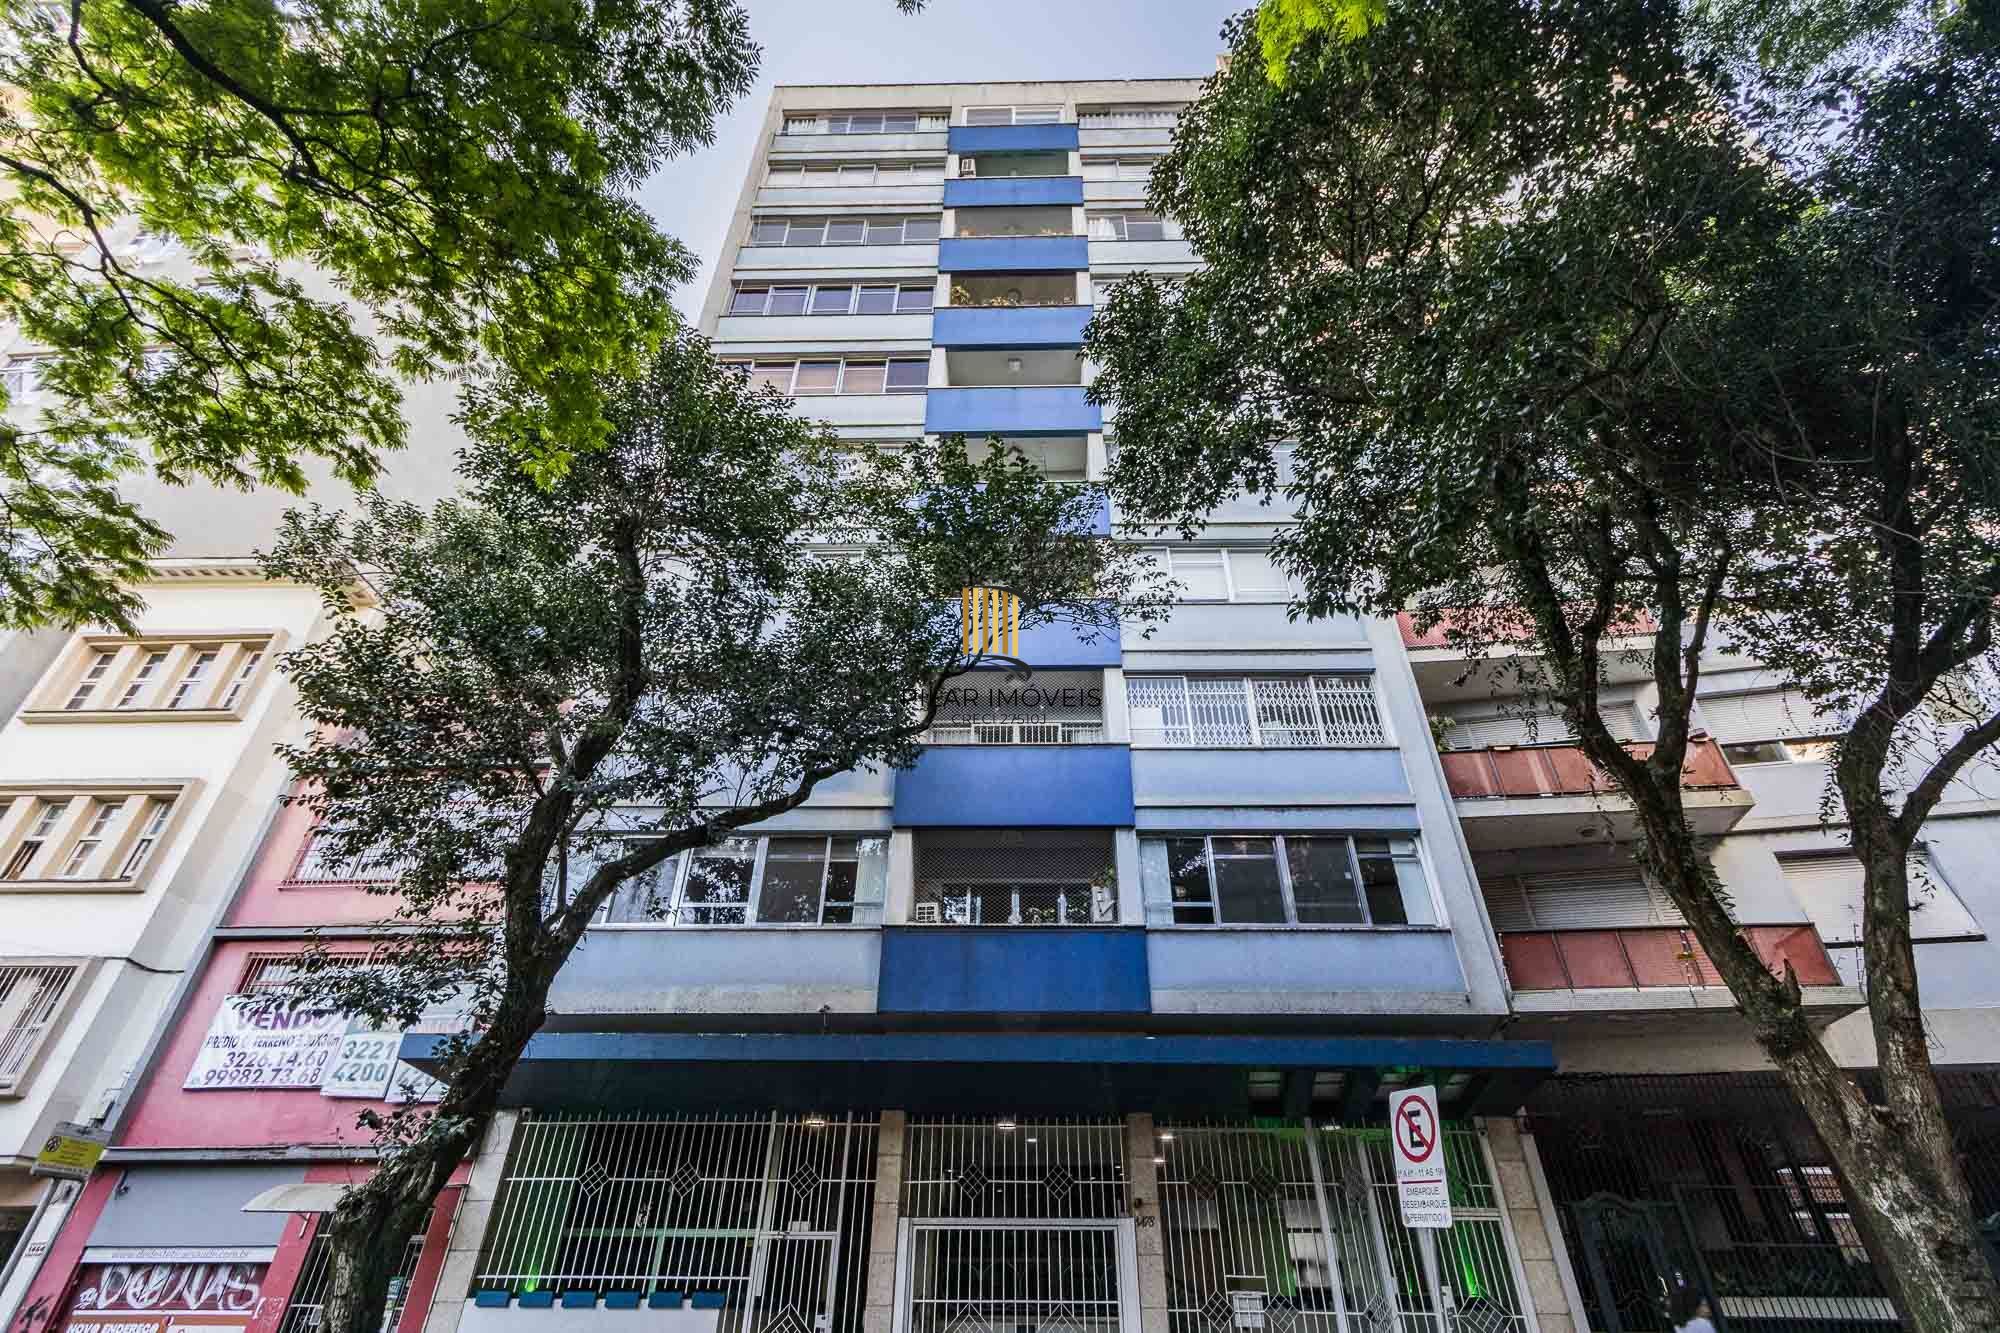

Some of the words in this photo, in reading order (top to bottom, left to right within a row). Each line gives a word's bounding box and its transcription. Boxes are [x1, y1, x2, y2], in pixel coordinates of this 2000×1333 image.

[342, 1040, 397, 1060] 3221
[332, 1063, 389, 1082] 4200
[1406, 1187, 1440, 1195] EMBARQUE
[1402, 1200, 1447, 1208] DESEMBARQUE
